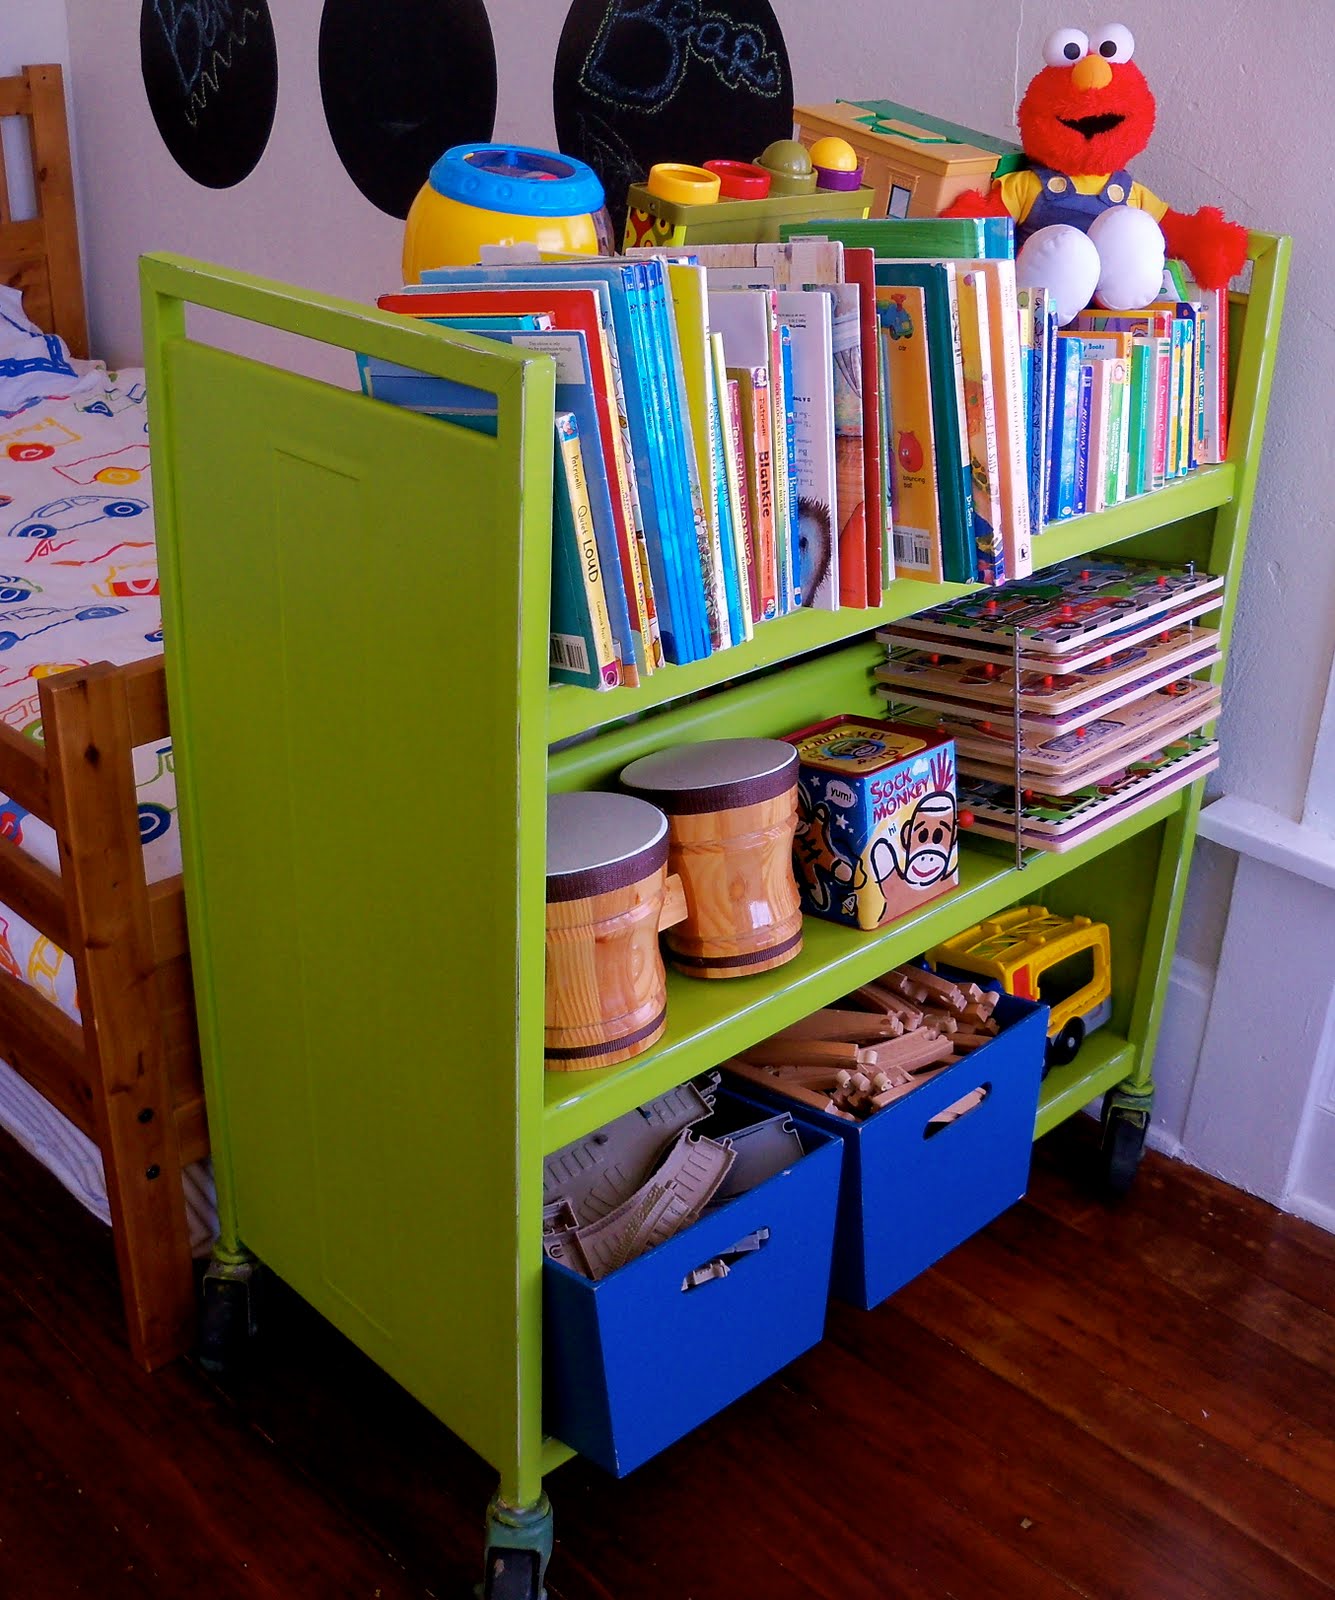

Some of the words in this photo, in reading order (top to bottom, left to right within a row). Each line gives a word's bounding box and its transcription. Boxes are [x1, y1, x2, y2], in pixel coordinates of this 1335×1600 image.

[1048, 367, 1056, 392] Happy
[773, 382, 781, 429] GOLDILOCKS
[984, 394, 992, 422] Today
[1047, 392, 1055, 430] Halloween
[732, 421, 741, 446] Ten
[1078, 407, 1088, 454] RUNAWAY
[571, 455, 582, 490] Patricelli
[735, 451, 745, 489] Little
[903, 475, 926, 484] bouncing
[987, 452, 995, 475] Silly
[1077, 456, 1085, 492] BUNNY
[757, 449, 773, 518] Blankie
[788, 476, 798, 520] Bathtime
[965, 493, 974, 508] Dr.
[578, 505, 588, 536] Quiet
[740, 493, 752, 566] Dinosaurs
[582, 539, 599, 584] LOUD
[830, 787, 853, 803] yum!
[870, 767, 912, 804] SOCK
[872, 776, 930, 824] MONKEY
[887, 822, 897, 837] hi
